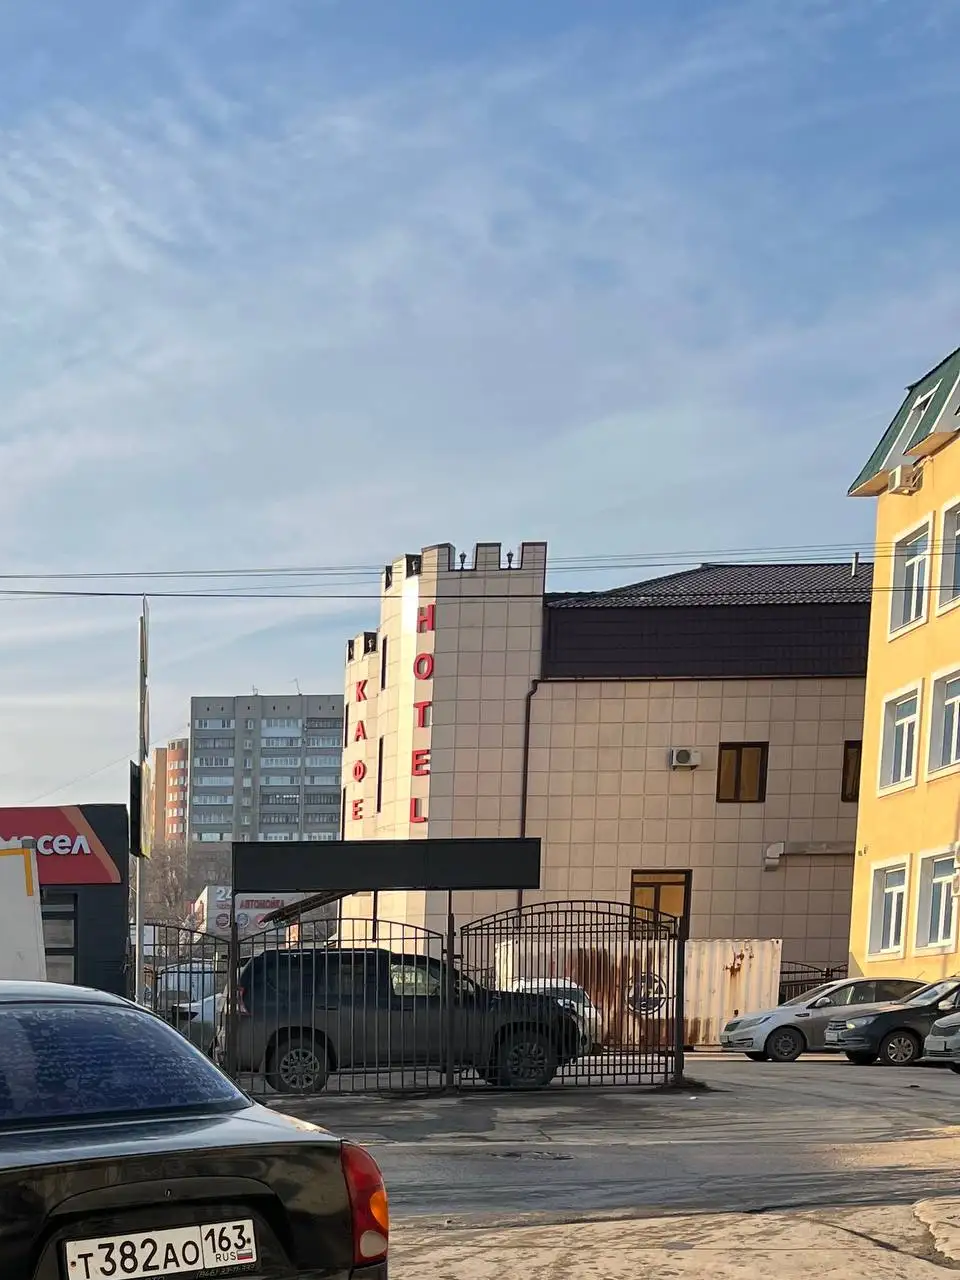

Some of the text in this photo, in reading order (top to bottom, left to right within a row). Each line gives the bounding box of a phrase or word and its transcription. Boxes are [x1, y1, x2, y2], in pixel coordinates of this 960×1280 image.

[352, 679, 368, 821] КАФЕ
[409, 603, 436, 824] HOTEL
[78, 1225, 246, 1279] Т382АО 163
[215, 1251, 236, 1263] RUS
